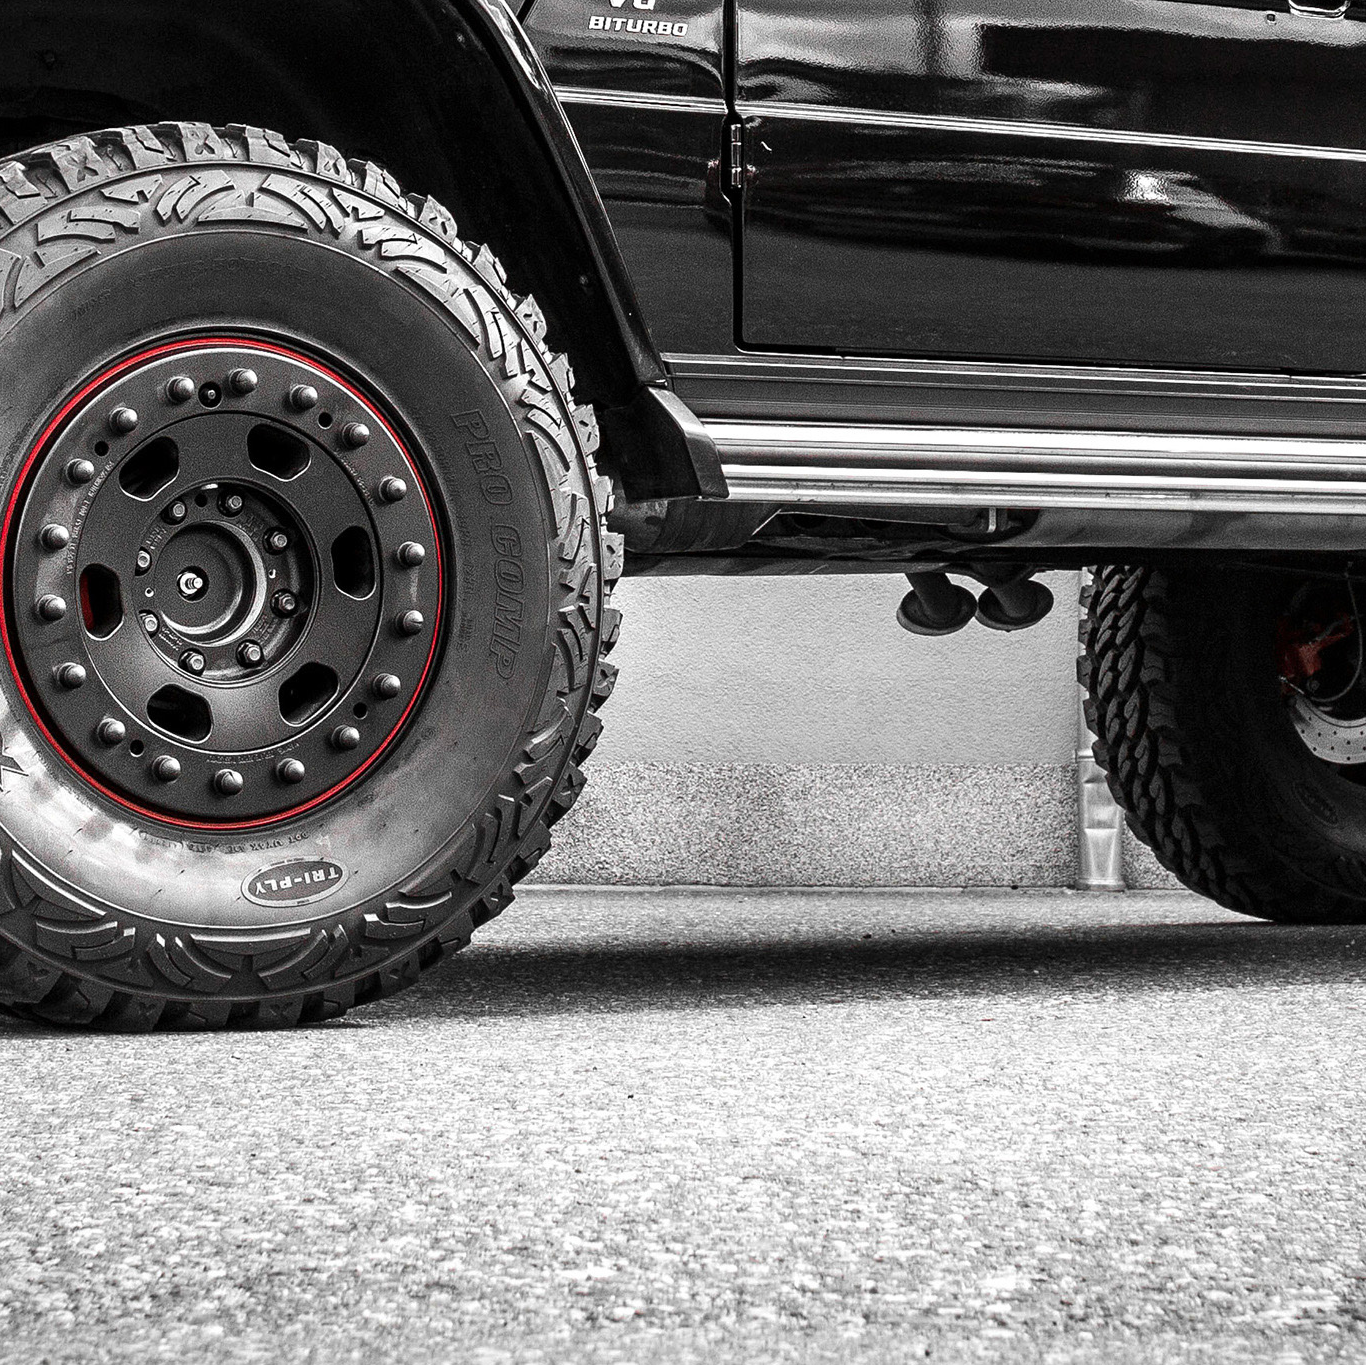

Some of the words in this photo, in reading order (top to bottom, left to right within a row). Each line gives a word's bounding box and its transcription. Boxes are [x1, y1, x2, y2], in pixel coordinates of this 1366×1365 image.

[588, 15, 689, 37] BITURBO
[450, 409, 513, 506] PRO
[492, 524, 525, 680] COMP
[254, 866, 340, 896] TRI-PLY
